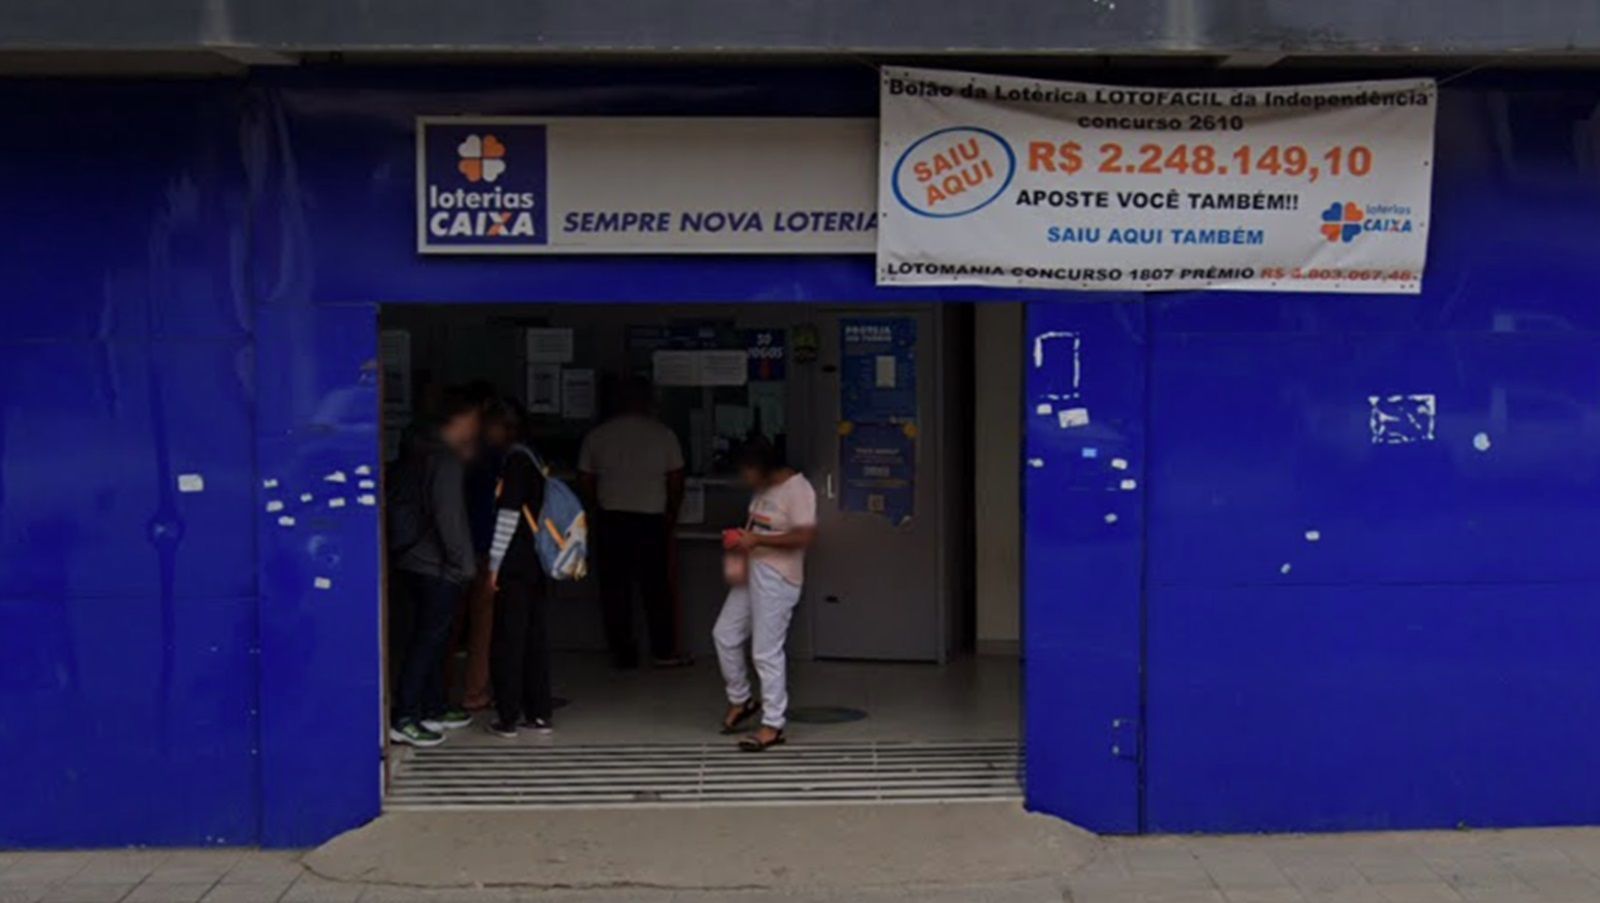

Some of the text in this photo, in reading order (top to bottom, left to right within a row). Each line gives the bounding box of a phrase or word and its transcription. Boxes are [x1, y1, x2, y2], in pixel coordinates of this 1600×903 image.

[889, 79, 1428, 109] Bolão da Lotérica LOTOFACIL da Independência
[1078, 115, 1244, 131] concurso 2610
[913, 137, 981, 183] SAIU
[1028, 141, 1372, 183] R$ 2.248.149,10
[925, 160, 995, 207] AQUI
[430, 185, 534, 209] loterias
[1016, 189, 1299, 210] APOSTE VOCÊ TAMBÉM!!
[430, 211, 535, 237] CAIXA
[563, 211, 878, 232] SEMPRE NOVA LOTERIA
[1363, 218, 1412, 233] CAIXA
[1048, 225, 1264, 245] SAIU AQUI TAMBÉM
[887, 262, 1005, 277] LOTOMANIA
[1011, 266, 1122, 281] CONCURSO
[1129, 268, 1174, 281] 1807
